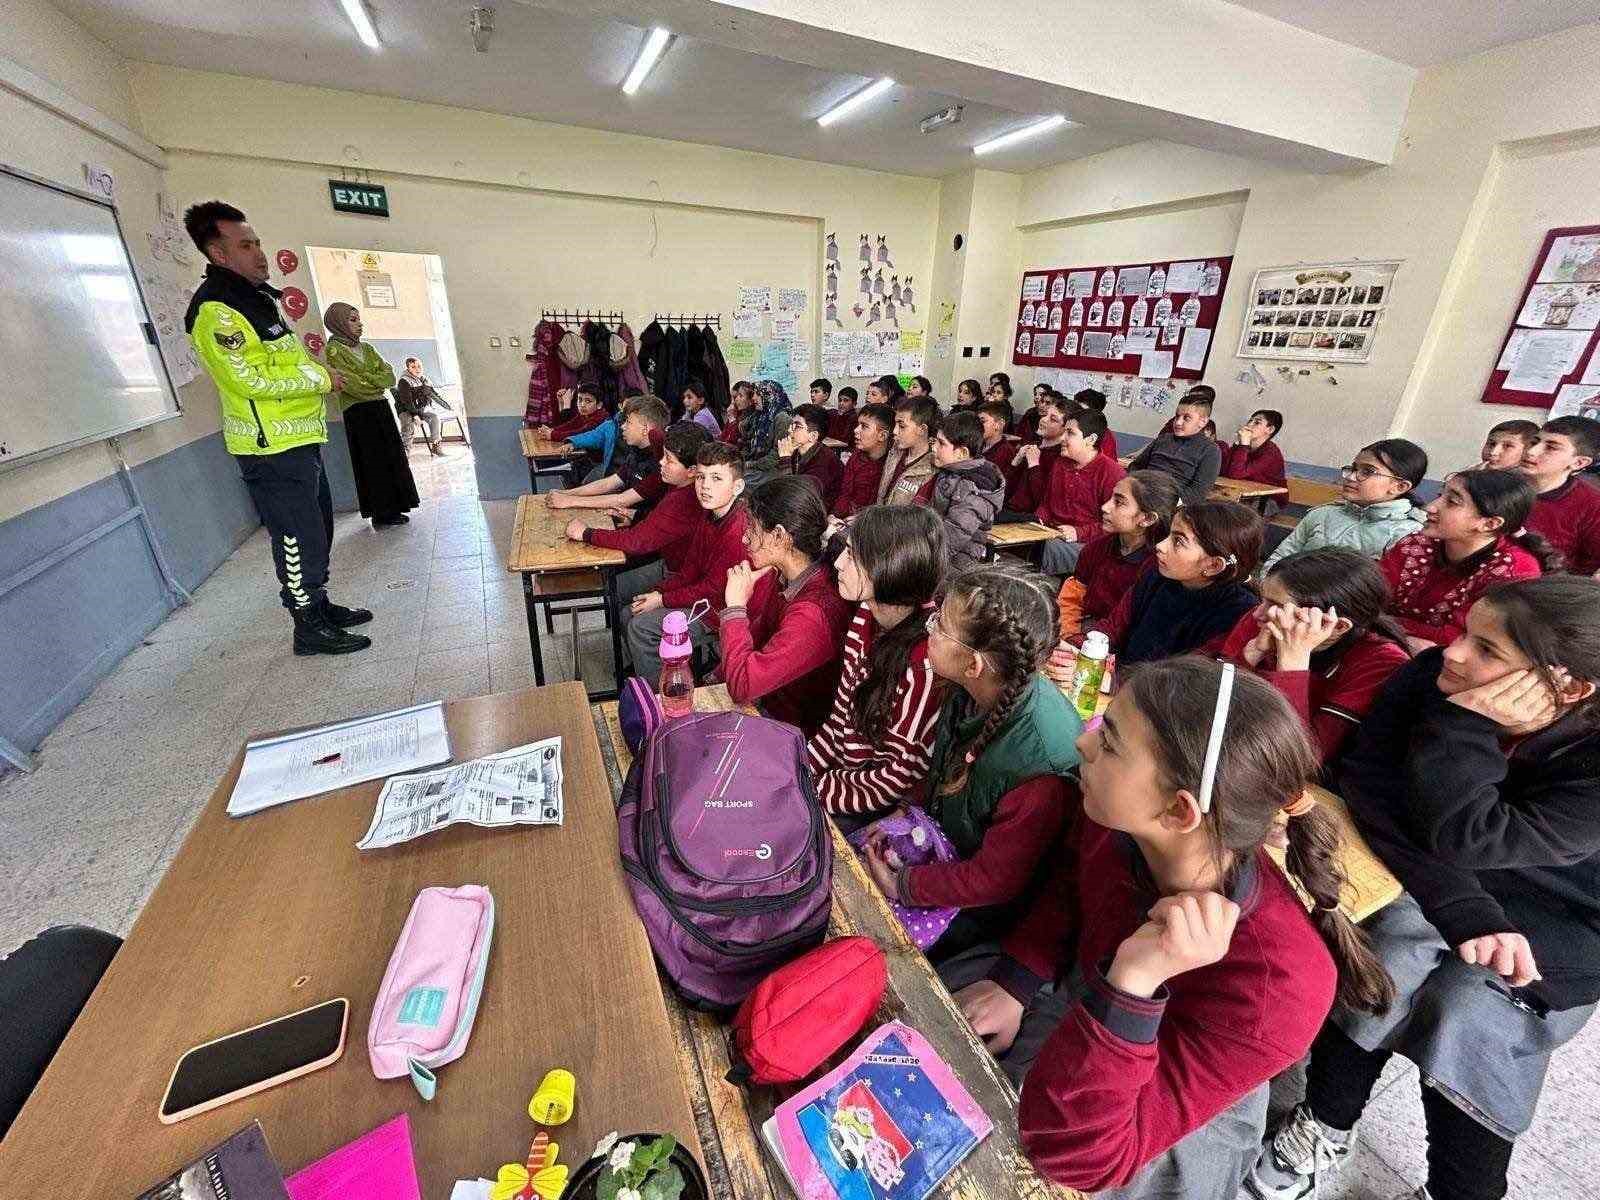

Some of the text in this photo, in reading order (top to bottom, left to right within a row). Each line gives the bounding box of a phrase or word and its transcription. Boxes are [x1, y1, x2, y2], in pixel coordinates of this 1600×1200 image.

[334, 188, 382, 207] EXIT
[704, 800, 753, 808] SPORT BAG
